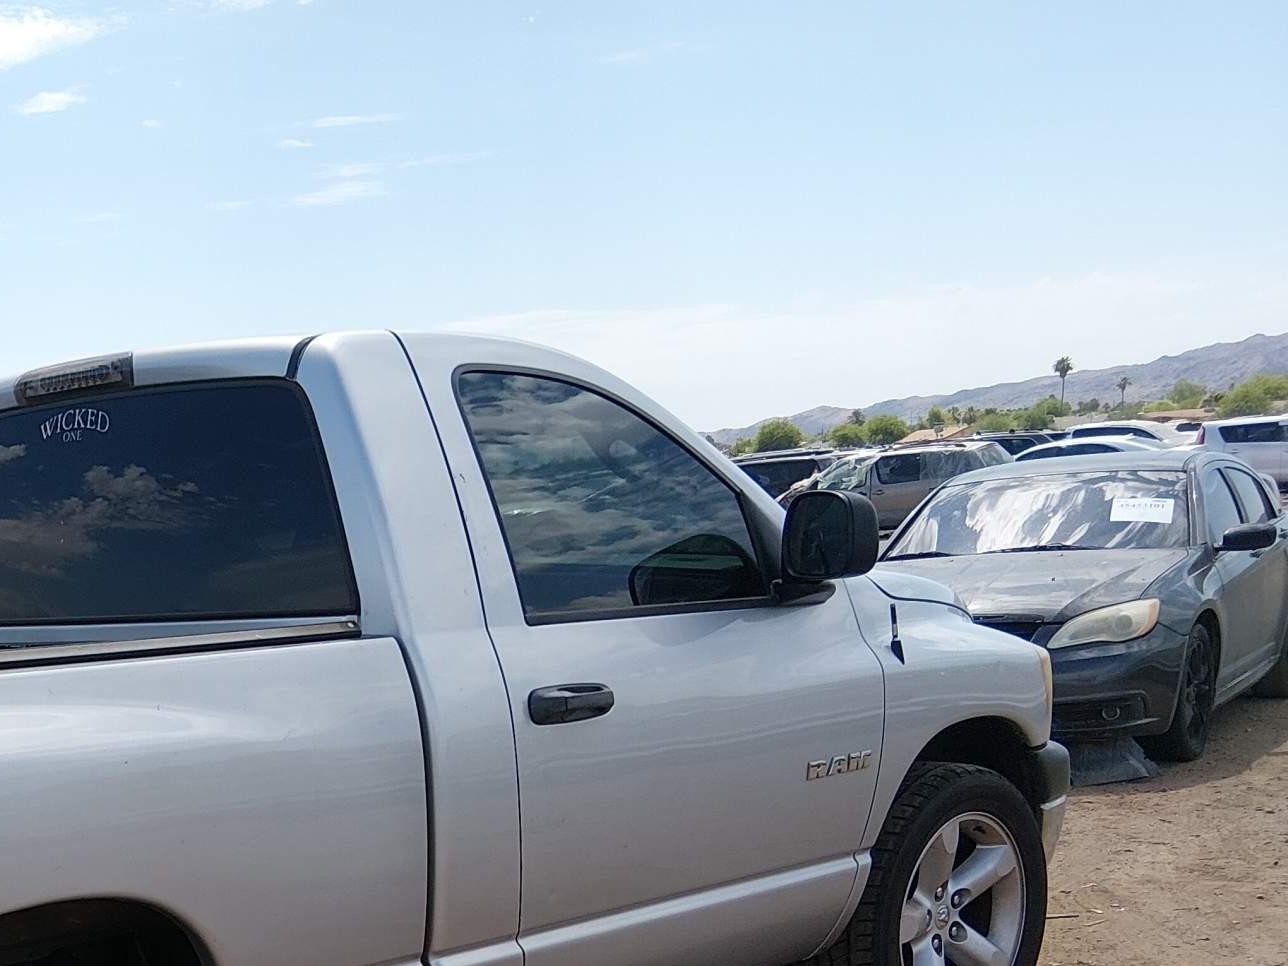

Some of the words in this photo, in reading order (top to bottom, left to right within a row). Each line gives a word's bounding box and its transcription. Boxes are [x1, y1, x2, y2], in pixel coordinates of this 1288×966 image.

[40, 408, 110, 441] WICKED
[62, 430, 83, 442] ONE
[806, 750, 872, 781] RAM
